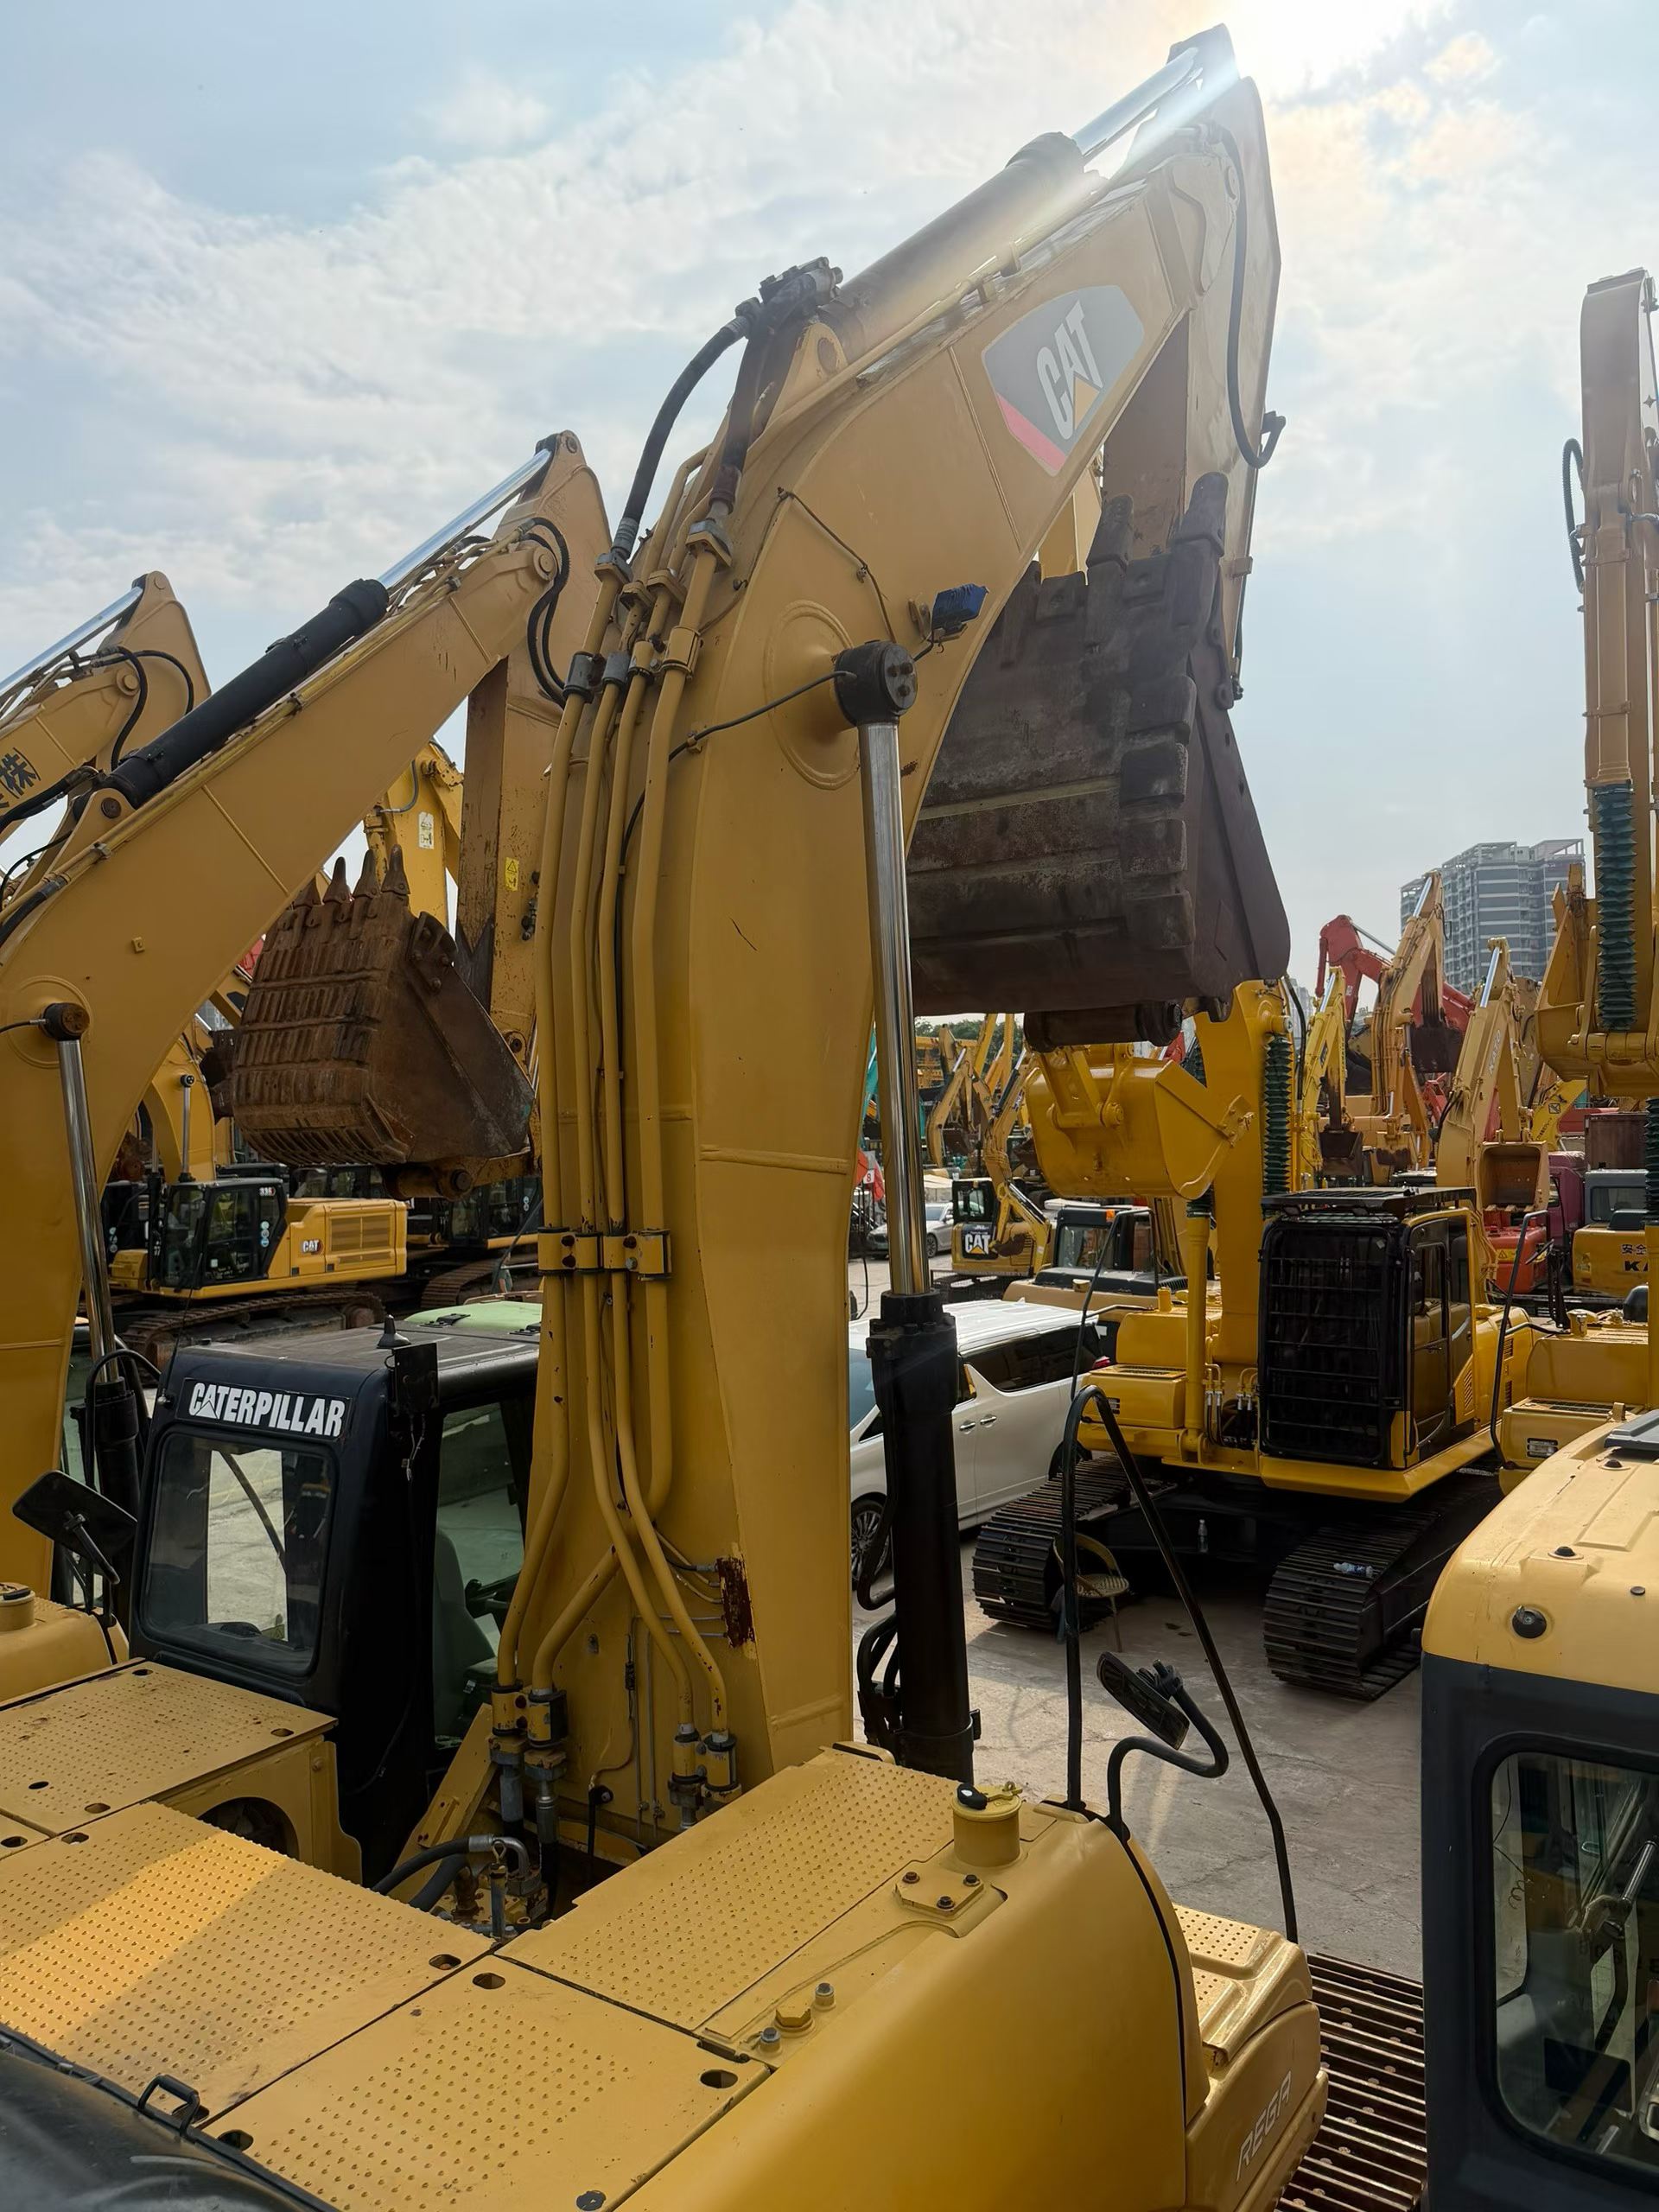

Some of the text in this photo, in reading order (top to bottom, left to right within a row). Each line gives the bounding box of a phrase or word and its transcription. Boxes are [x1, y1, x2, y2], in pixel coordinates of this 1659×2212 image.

[1037, 300, 1103, 440] CAT
[0, 747, 41, 809] (株)
[302, 1239, 320, 1253] CAT
[964, 1234, 991, 1255] CAT
[188, 1382, 346, 1438] CATERPILLAR
[1236, 2070, 1292, 2183] REGA
